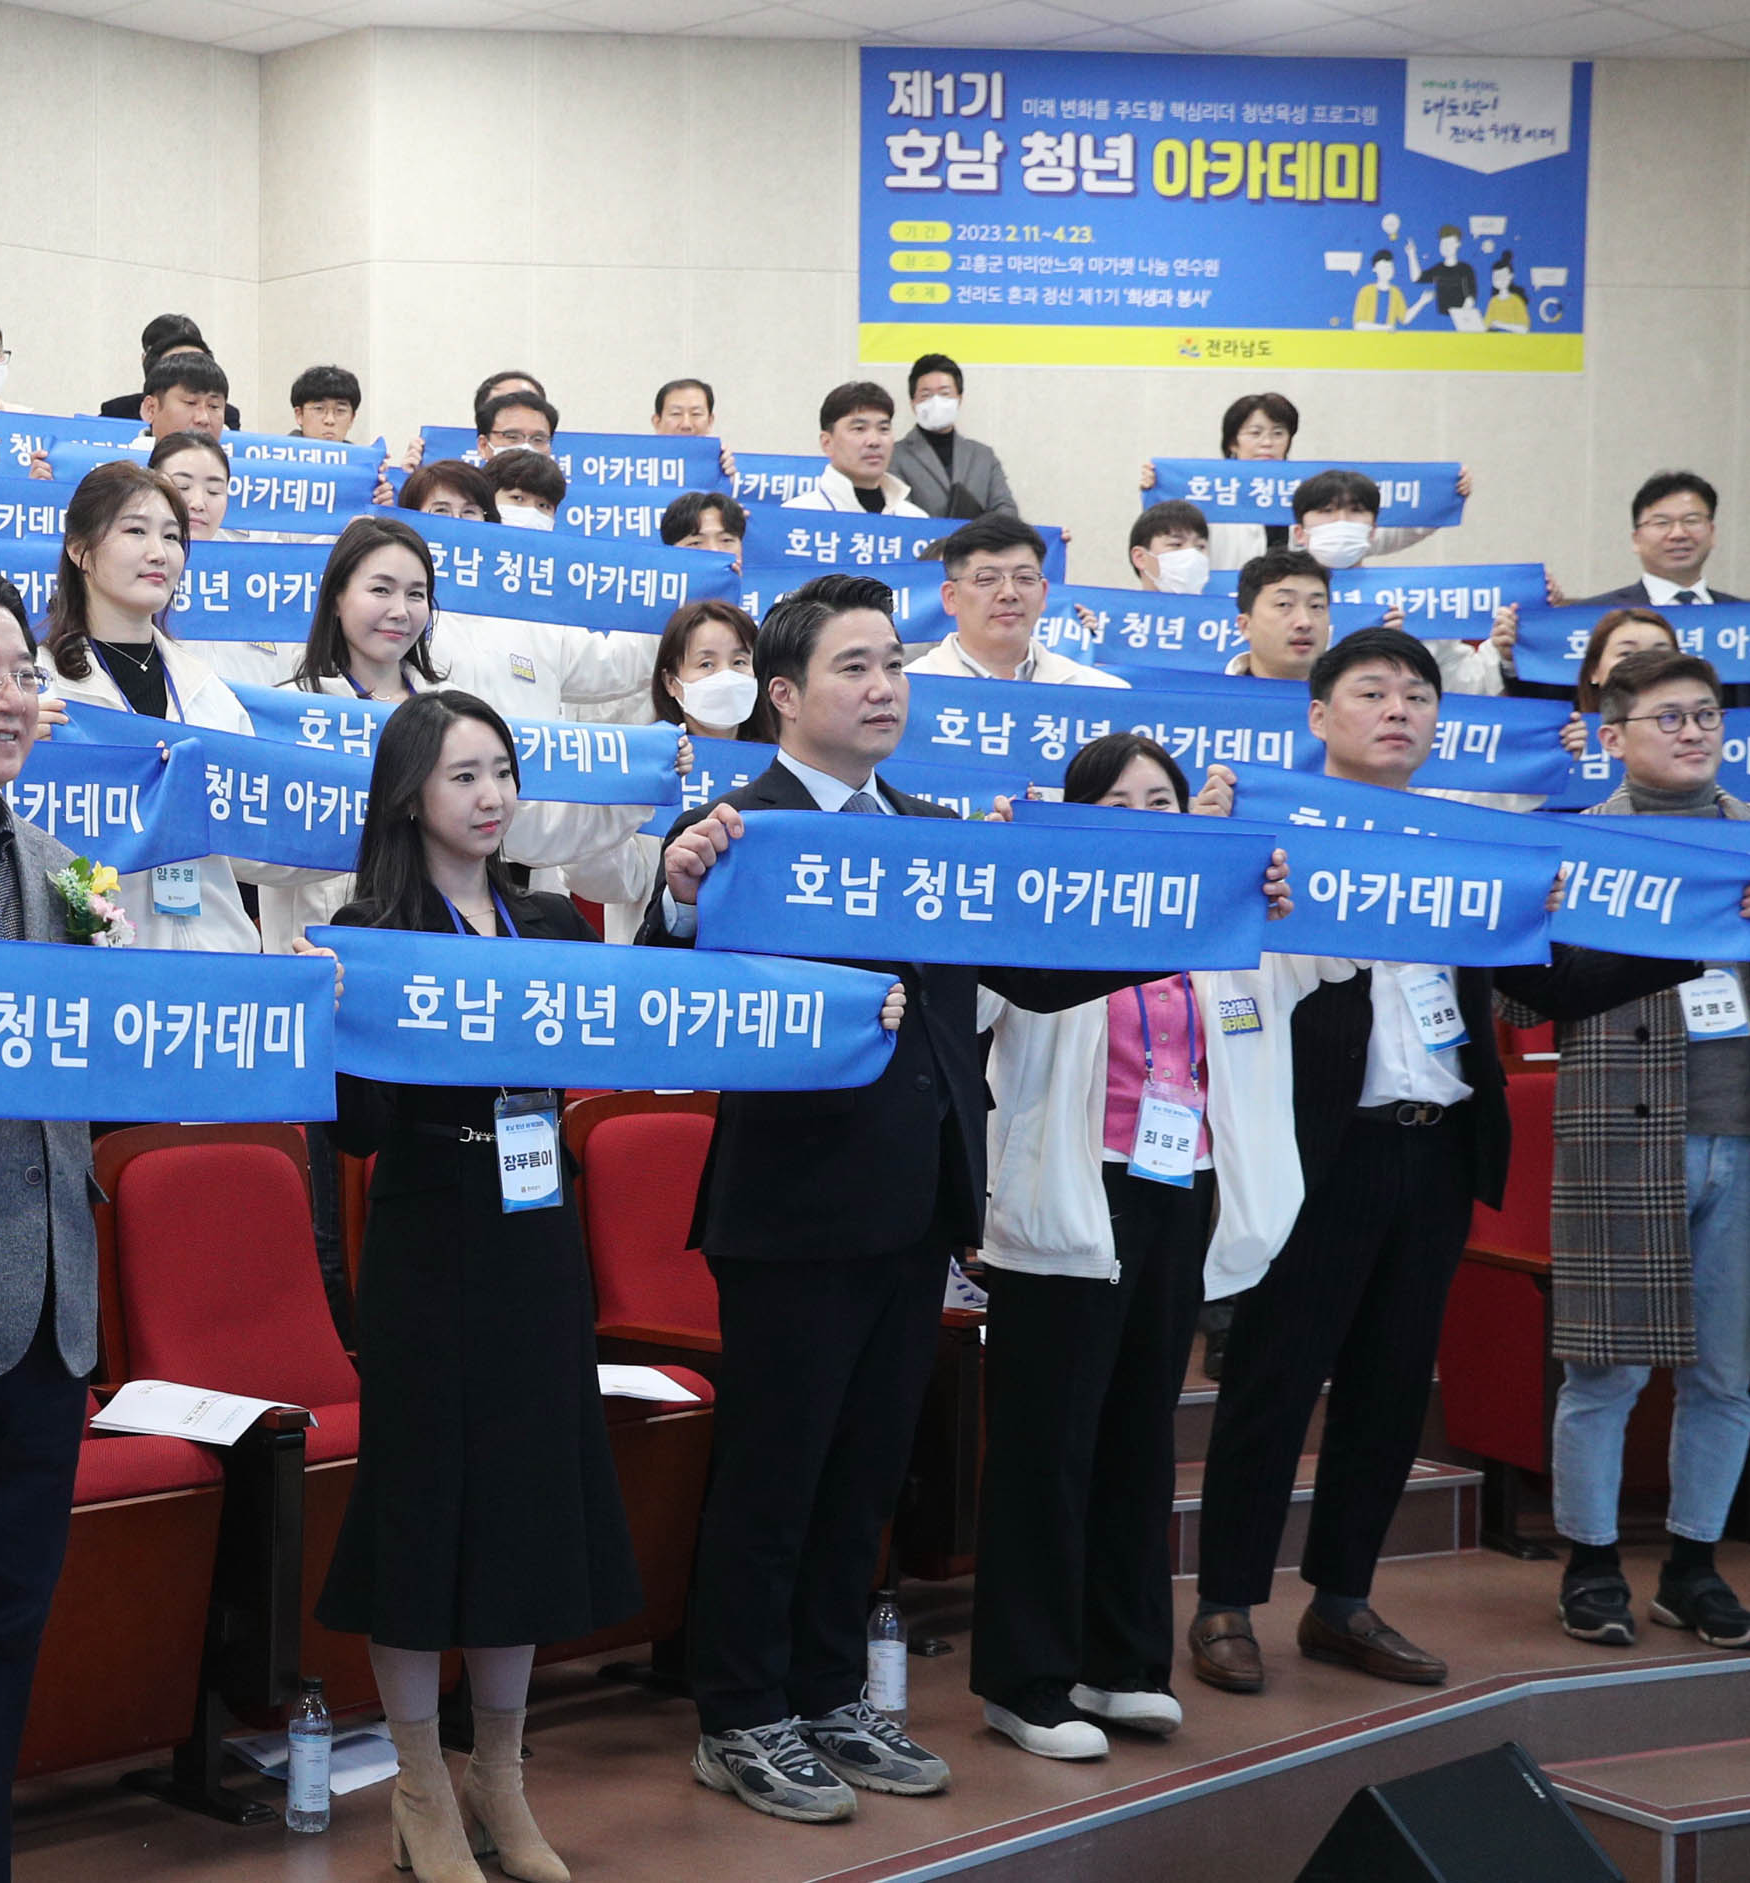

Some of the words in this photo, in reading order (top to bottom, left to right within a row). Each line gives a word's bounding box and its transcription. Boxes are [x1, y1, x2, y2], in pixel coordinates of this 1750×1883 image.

[888, 70, 1004, 118] 제1기
[1021, 98, 1056, 118] 미래
[1060, 99, 1109, 120] 변화를
[1114, 101, 1164, 122] 주도할
[1170, 102, 1235, 123] 핵심리더
[1312, 105, 1378, 126] 프로그램
[884, 128, 1004, 190] 호남
[1020, 130, 1135, 194] 청년
[1153, 137, 1378, 201] 아카데미
[956, 255, 1003, 273] 고흥군
[956, 288, 1003, 304] 전라도
[1205, 339, 1272, 358] 전라남도
[583, 456, 684, 487] 아카데미
[1185, 476, 1240, 505] 호남
[227, 475, 336, 513] 아카데미
[785, 529, 840, 563] 호남
[849, 533, 901, 564] 청년
[246, 572, 320, 612] 아카
[427, 542, 483, 587] 호남
[494, 551, 554, 596] 청년
[568, 562, 688, 609] 아카데미
[1375, 587, 1501, 619] 아카데미
[1120, 612, 1185, 651] 청년
[296, 709, 377, 756] 호남
[511, 725, 629, 774] 카데미
[932, 708, 1016, 755] 호남
[205, 764, 268, 825] 청년
[681, 771, 714, 811] 남
[786, 854, 885, 916] 호남
[903, 859, 995, 921] 청년
[1018, 868, 1199, 928] 아카데미
[1309, 869, 1502, 930] 아카데미
[1560, 861, 1682, 924] 카데미
[398, 975, 502, 1041] 호남
[522, 980, 615, 1045] 청년
[640, 987, 823, 1048] 아카데미
[114, 1001, 305, 1069] 아카데미
[503, 1149, 553, 1172] 장푸름이
